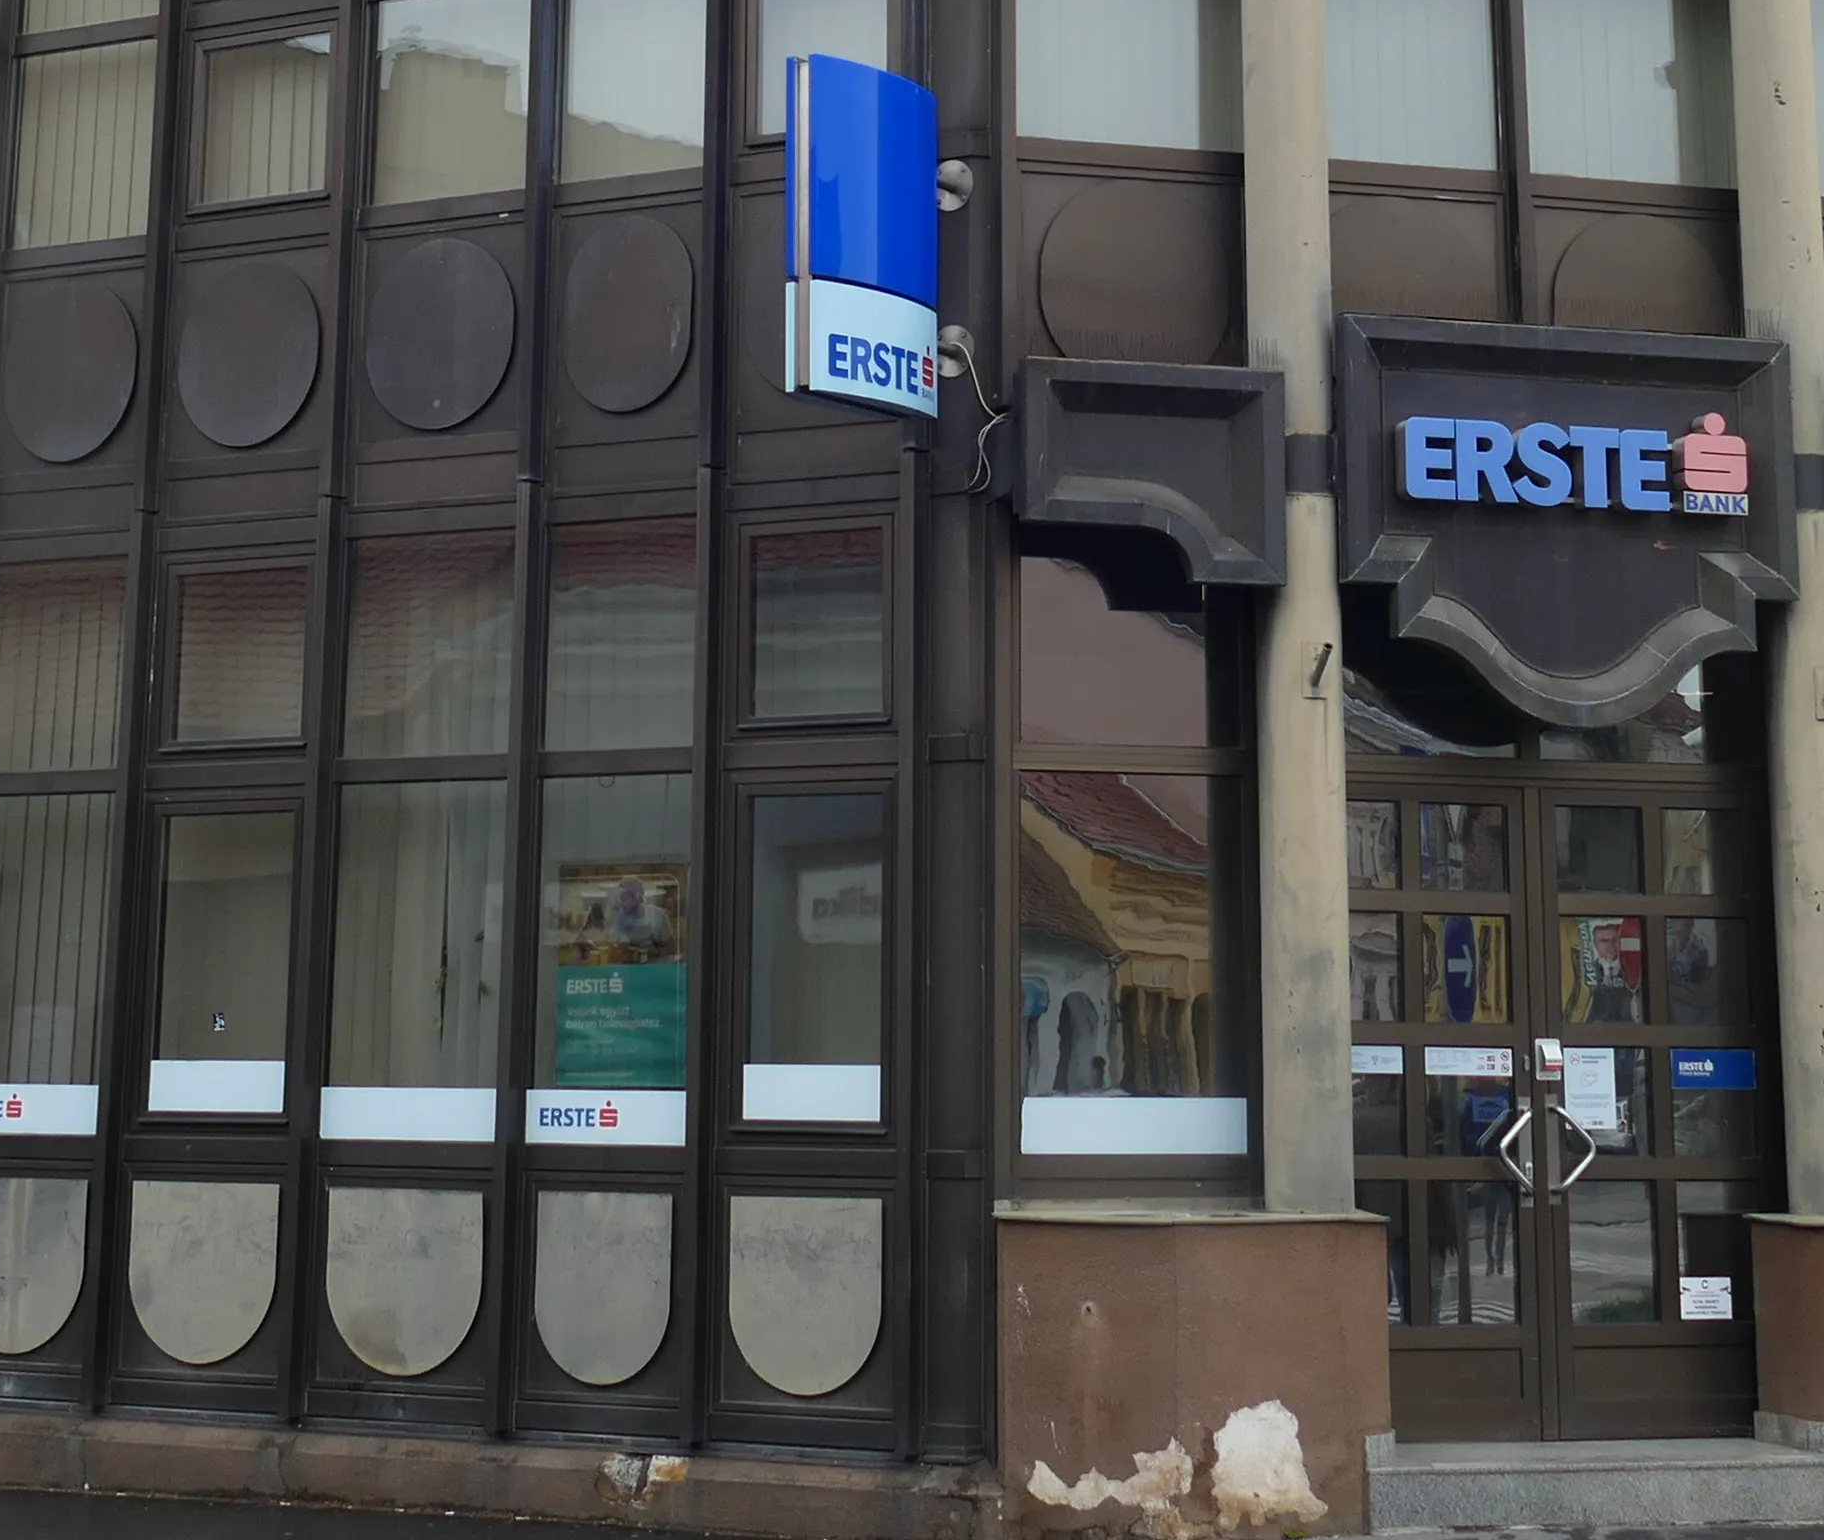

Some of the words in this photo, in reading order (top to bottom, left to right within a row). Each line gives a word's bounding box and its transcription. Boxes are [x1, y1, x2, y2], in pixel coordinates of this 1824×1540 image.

[828, 333, 918, 396] ERSTE
[1396, 416, 1671, 513] ERSTE
[1685, 493, 1747, 515] BANK
[566, 978, 607, 994] ERSTE
[539, 1107, 596, 1129] ERSTE
